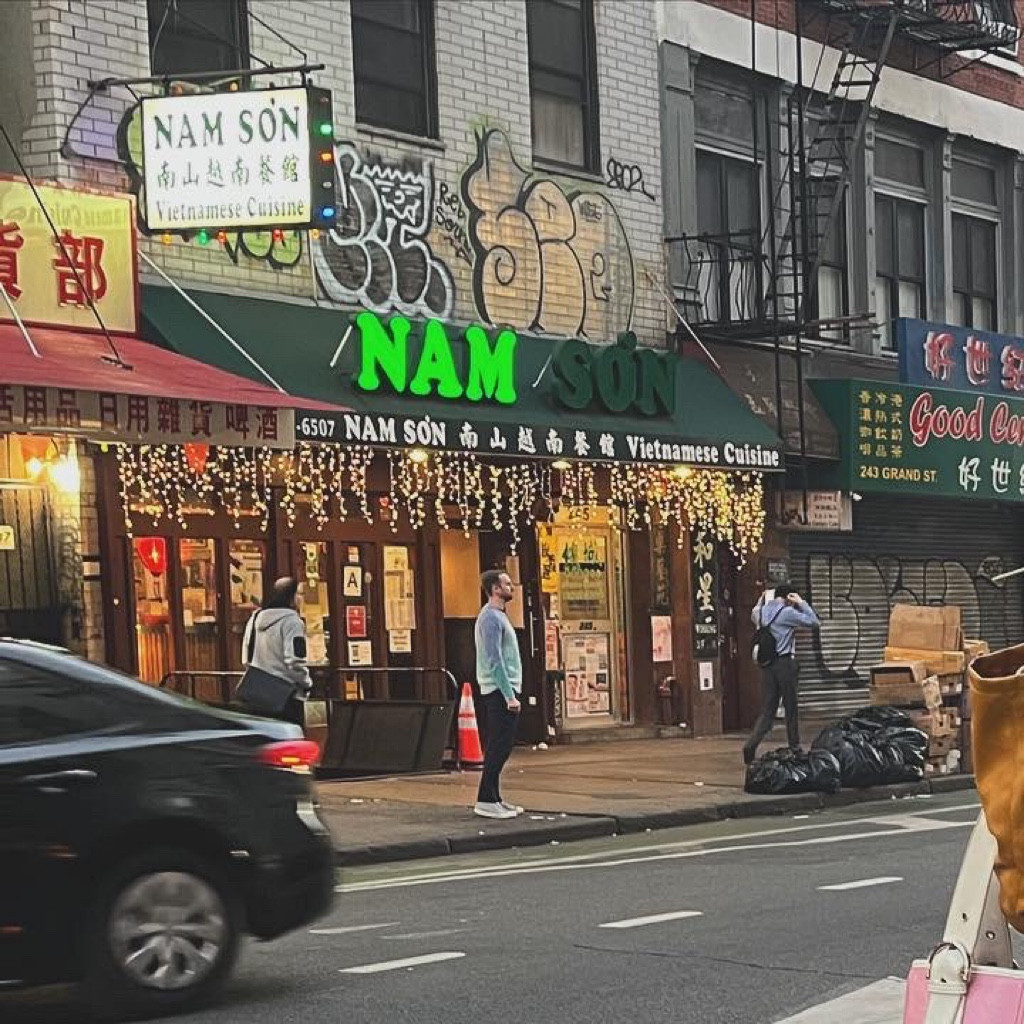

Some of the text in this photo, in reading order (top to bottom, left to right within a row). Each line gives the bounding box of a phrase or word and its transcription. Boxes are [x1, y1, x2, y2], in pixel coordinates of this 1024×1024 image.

[154, 110, 225, 150] NAM
[157, 153, 300, 191] 南山越南餐館
[156, 196, 305, 222] Vietnamese Cuisine
[356, 311, 518, 405] NAM
[225, 405, 278, 441] 啤酒
[909, 392, 985, 447] Good
[343, 414, 398, 443] NAM
[459, 421, 616, 458] 南山越南餐館
[626, 435, 719, 463] Vietnamese
[723, 442, 780, 468] Cuisine
[859, 465, 880, 479] 243
[881, 466, 920, 482] GRAND
[346, 572, 358, 588] A
